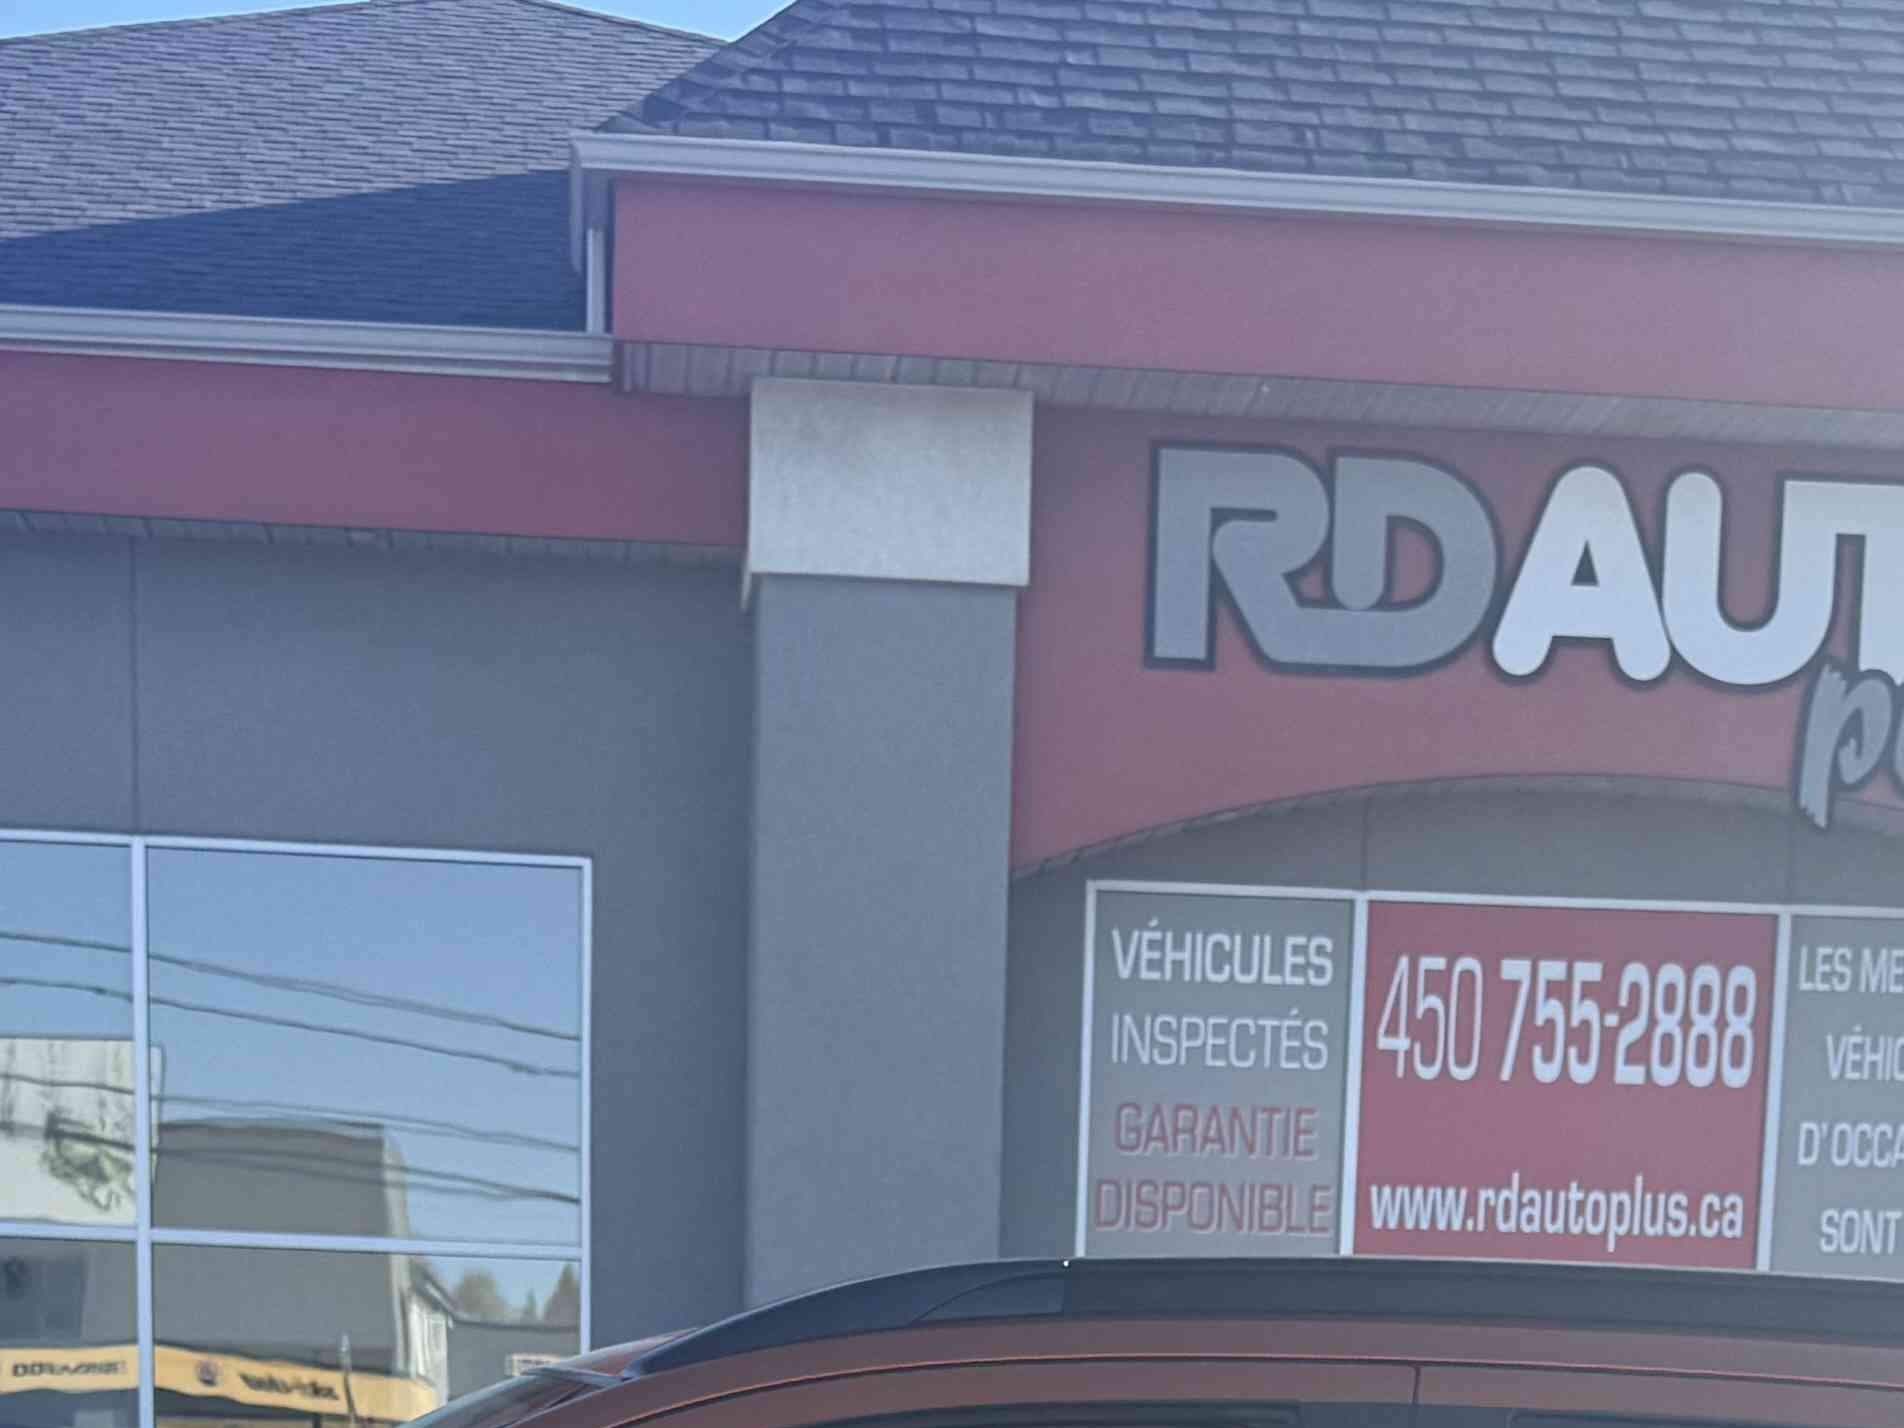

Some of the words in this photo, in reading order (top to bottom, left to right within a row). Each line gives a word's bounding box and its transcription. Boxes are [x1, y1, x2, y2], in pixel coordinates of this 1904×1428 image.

[1111, 916, 1334, 987] VÉHICULES
[1799, 945, 1853, 992] LES
[1110, 1008, 1330, 1071] INSPECTÉS
[1376, 954, 1484, 1081] 450
[1499, 958, 1757, 1089] 755-2888
[1114, 1101, 1321, 1161] GARANTIE
[1095, 1178, 1335, 1238] DISPONIBLE
[1369, 1170, 1745, 1253] www.rdautoplus.ca
[1819, 1208, 1902, 1255] SONT
